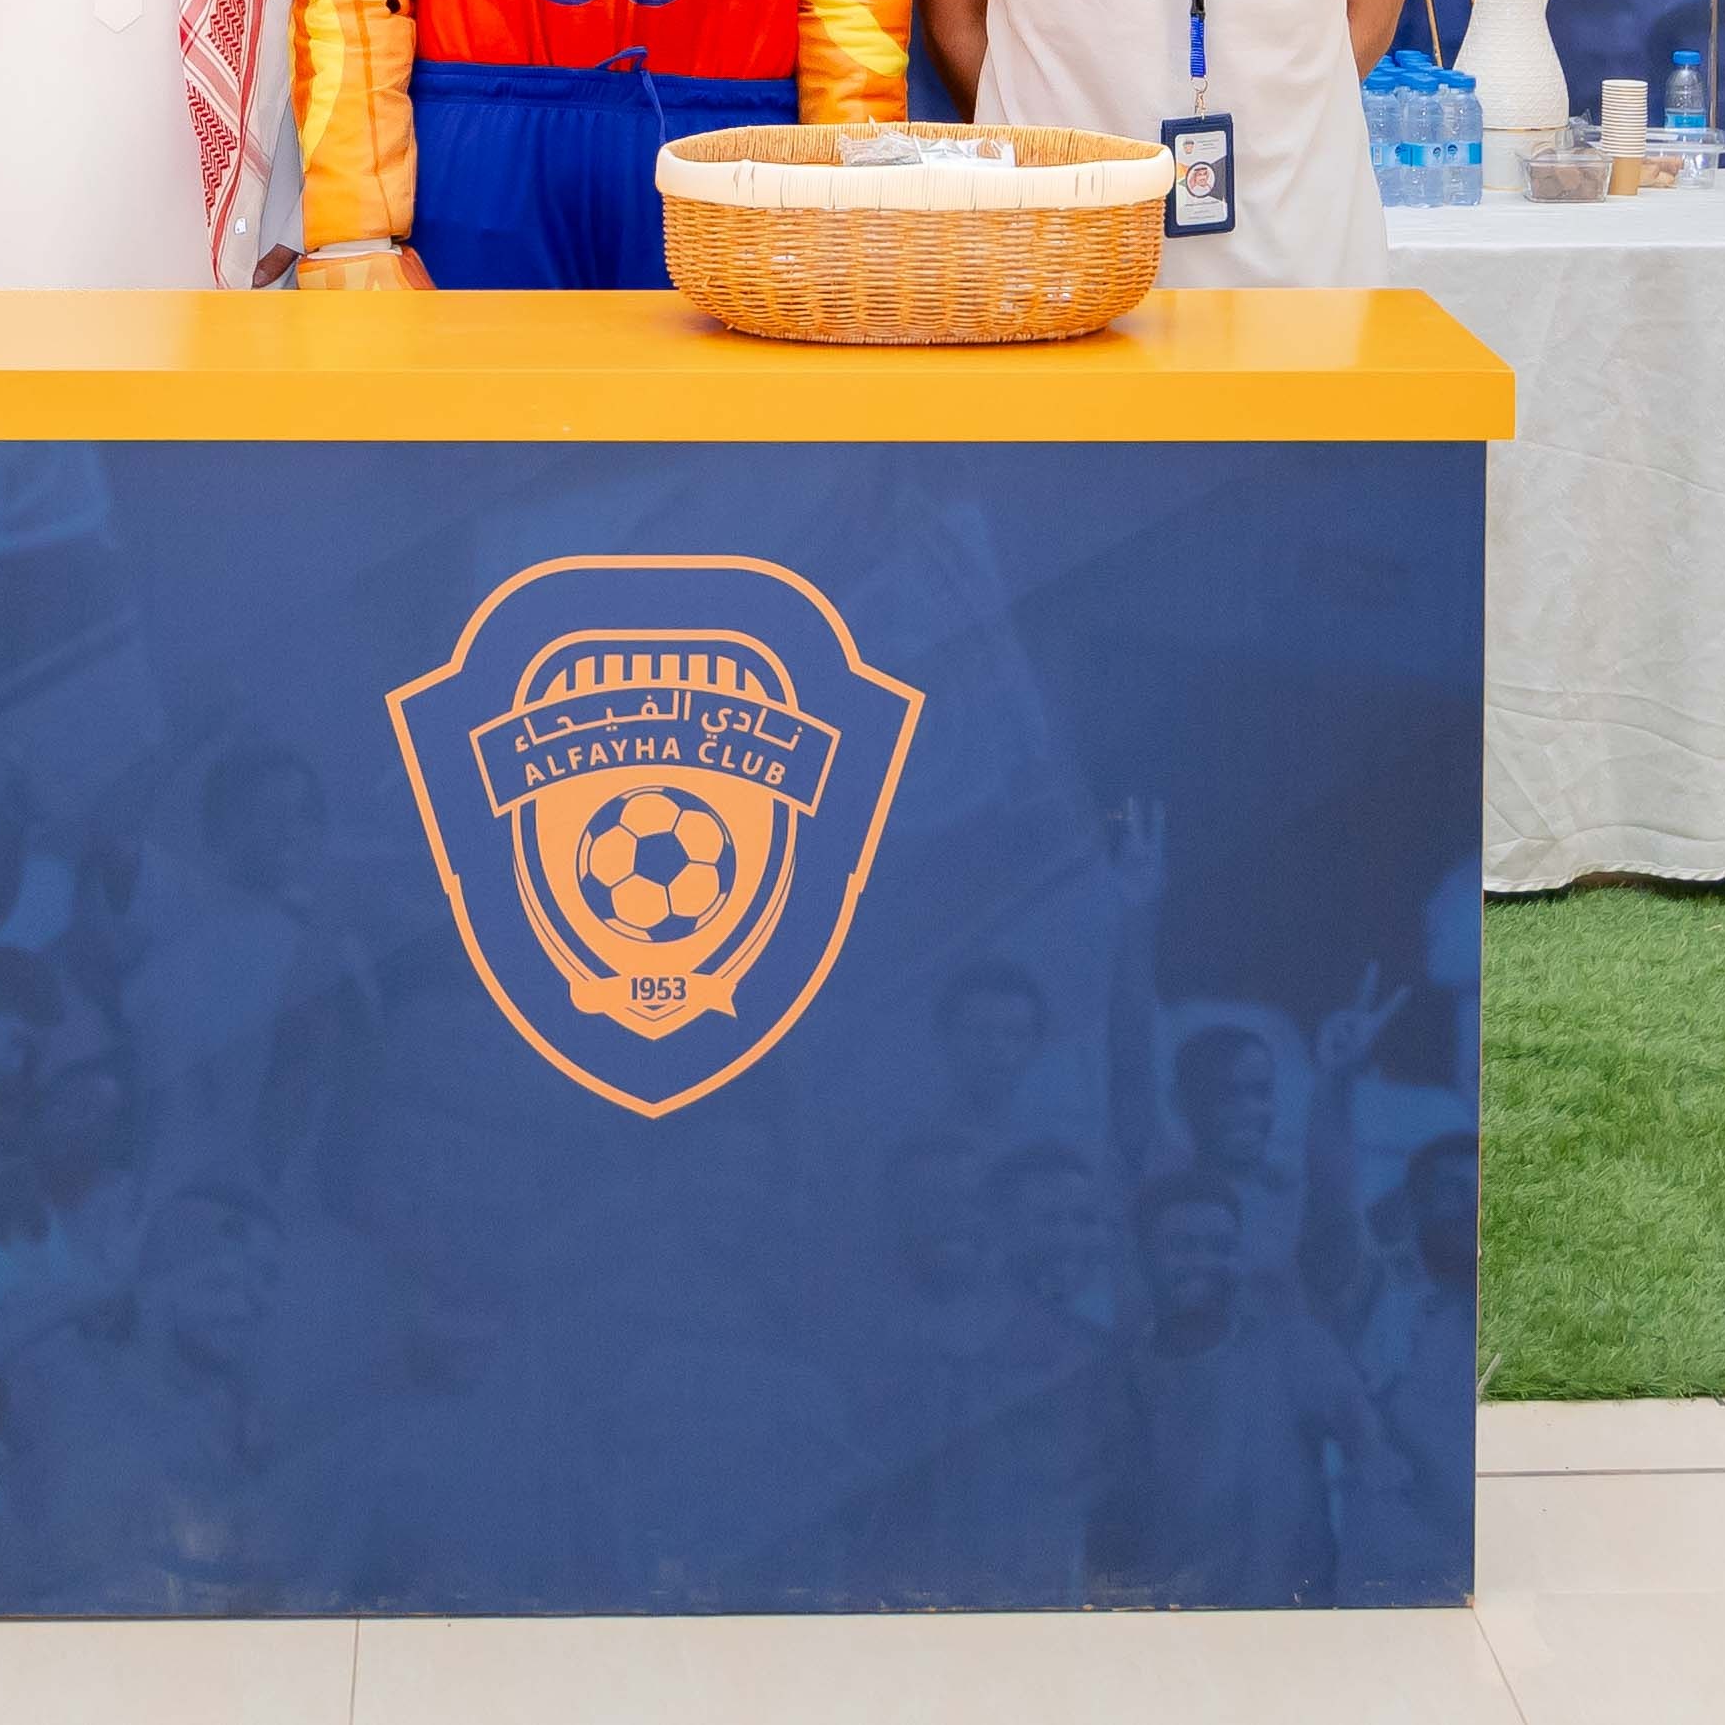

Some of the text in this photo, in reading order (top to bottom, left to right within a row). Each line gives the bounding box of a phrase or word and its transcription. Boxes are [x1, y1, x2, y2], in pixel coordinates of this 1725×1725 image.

[514, 690, 804, 753] نادي الفيحاء
[524, 737, 787, 787] ALFAYHA CLUB
[631, 977, 687, 1000] 1953
